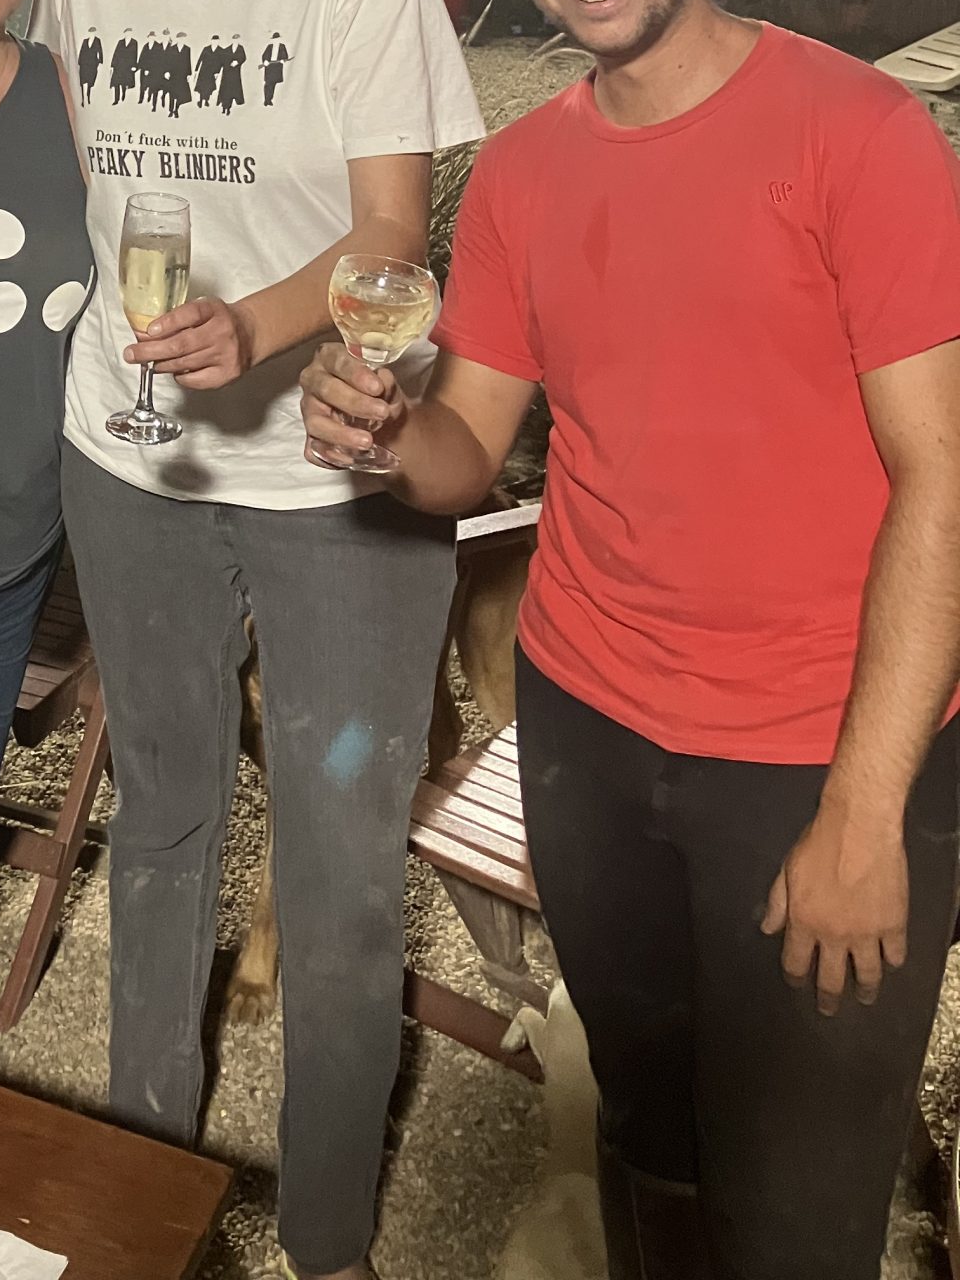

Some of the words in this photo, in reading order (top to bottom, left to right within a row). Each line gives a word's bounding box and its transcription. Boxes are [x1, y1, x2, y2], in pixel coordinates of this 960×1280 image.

[139, 132, 171, 147] fuck
[176, 135, 209, 149] with
[214, 137, 238, 150] the
[87, 146, 146, 178] PEAKY
[158, 151, 256, 184] BLINDERS
